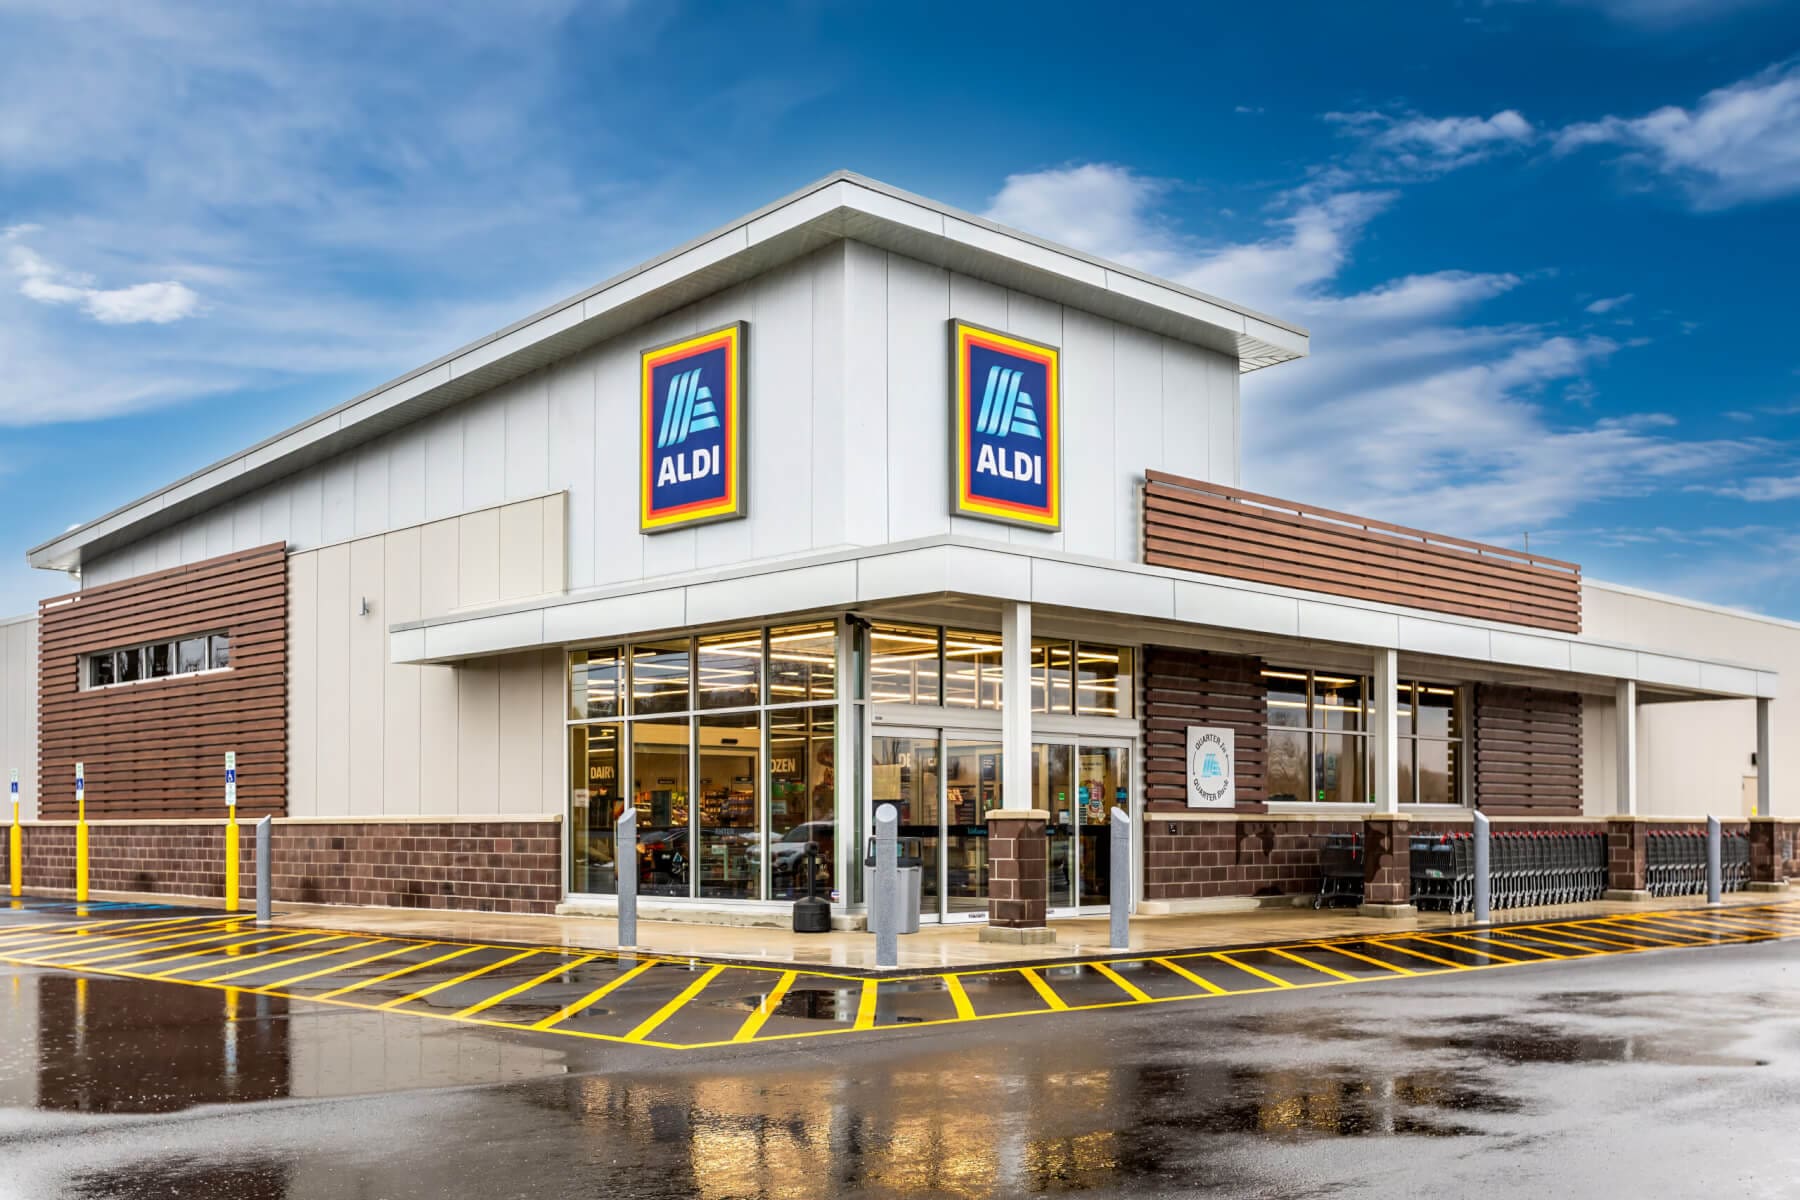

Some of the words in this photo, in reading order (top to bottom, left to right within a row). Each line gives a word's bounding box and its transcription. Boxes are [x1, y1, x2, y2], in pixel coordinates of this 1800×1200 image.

[657, 444, 720, 488] ALDI
[976, 443, 1042, 485] ALDI
[1195, 733, 1221, 751] QUARTER
[1193, 778, 1217, 801] QUARTER
